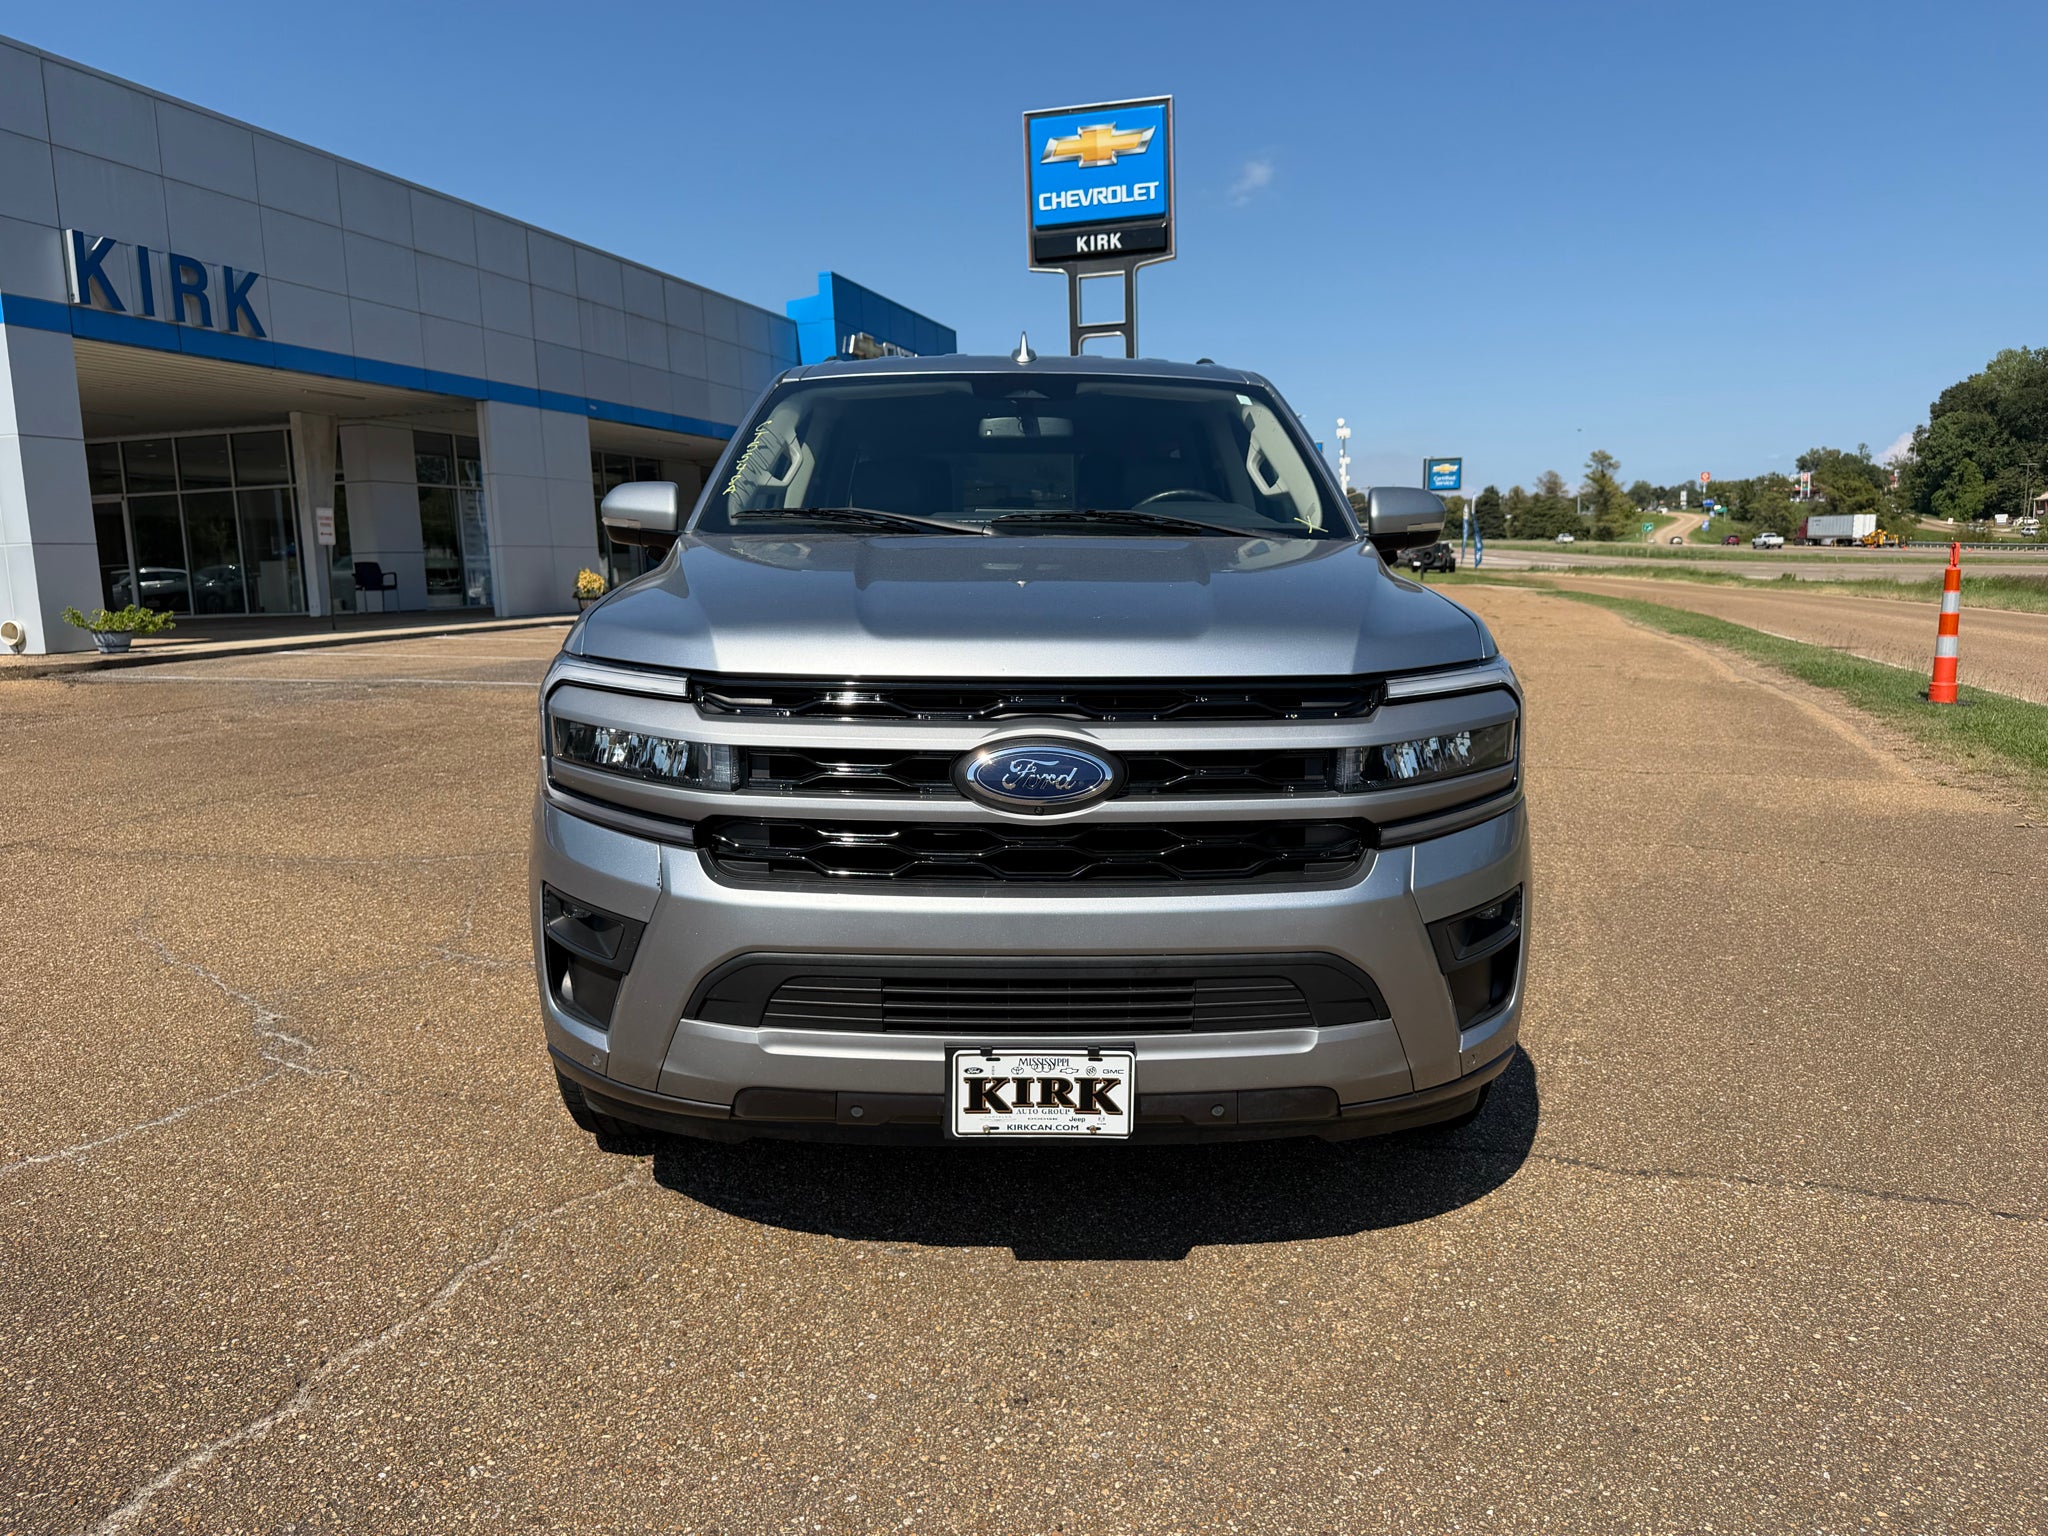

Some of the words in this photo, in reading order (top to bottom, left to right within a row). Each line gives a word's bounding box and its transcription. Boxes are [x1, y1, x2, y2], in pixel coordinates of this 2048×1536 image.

[1038, 181, 1160, 211] CHEVROLET
[1076, 232, 1122, 252] KIRK
[66, 229, 267, 338] KIRK
[1001, 758, 1078, 790] Ford
[1018, 1057, 1070, 1073] MISSISSIPPI
[963, 1076, 1123, 1116] KIRK
